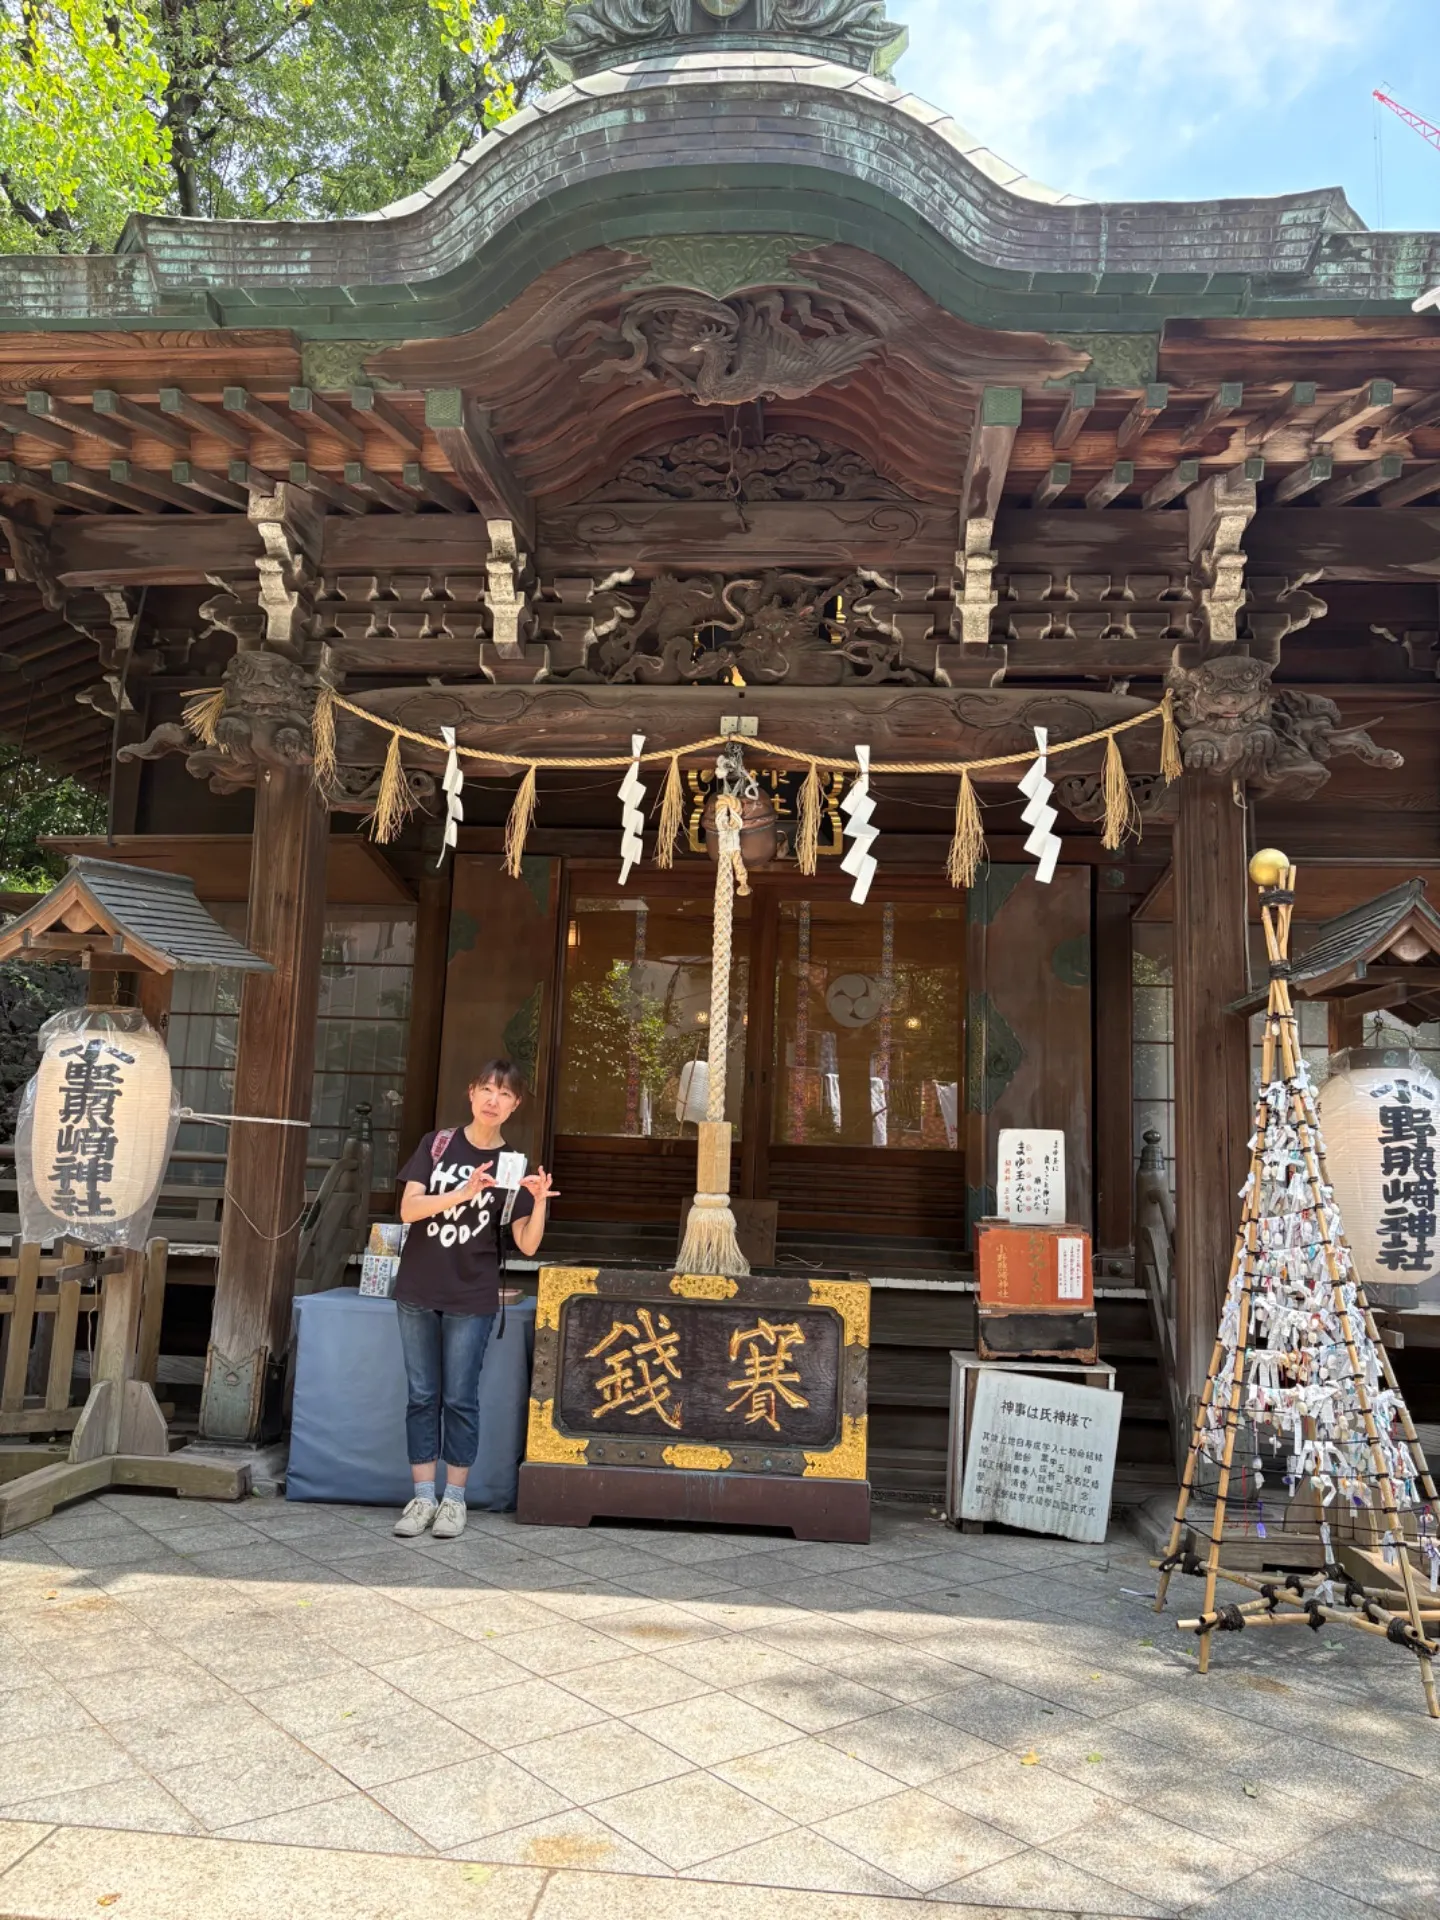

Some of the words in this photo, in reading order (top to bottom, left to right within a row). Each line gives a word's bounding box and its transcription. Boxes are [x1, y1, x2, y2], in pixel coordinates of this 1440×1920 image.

[1015, 1140, 1025, 1213] まゆ玉みくじ
[1000, 1400, 1093, 1429] 神事は氏神様で
